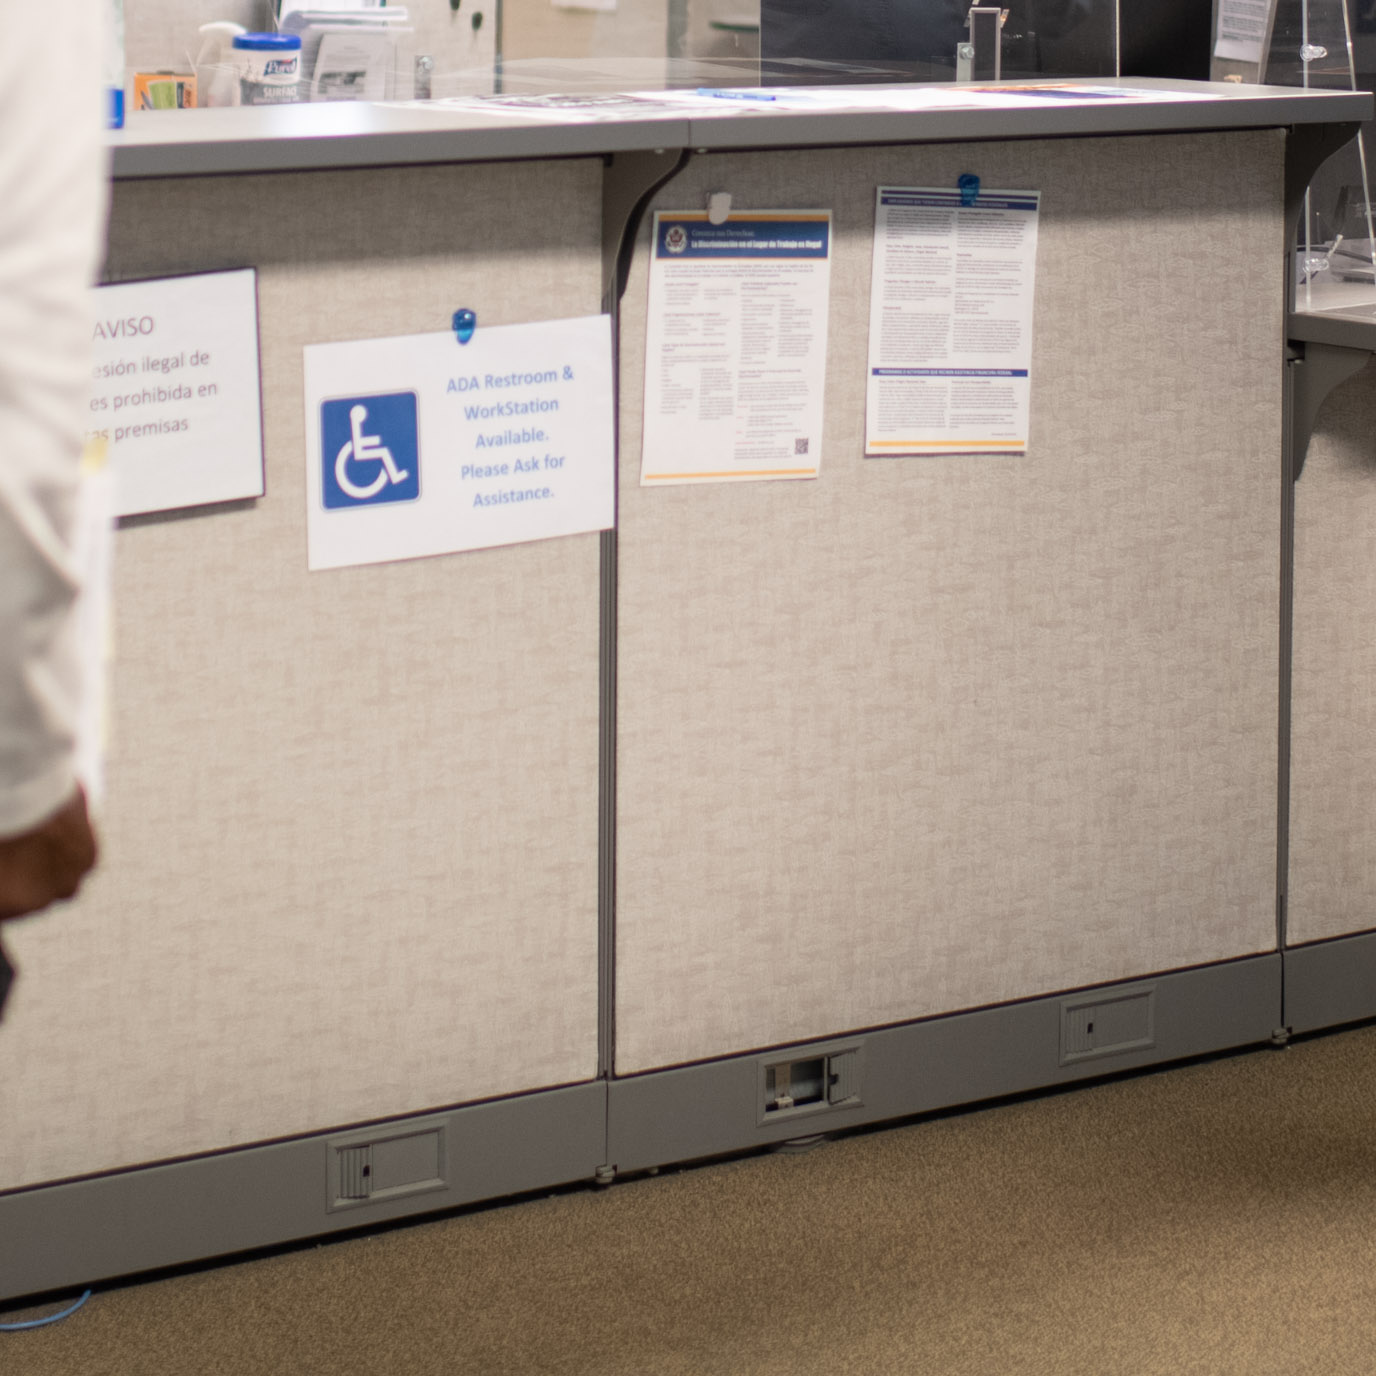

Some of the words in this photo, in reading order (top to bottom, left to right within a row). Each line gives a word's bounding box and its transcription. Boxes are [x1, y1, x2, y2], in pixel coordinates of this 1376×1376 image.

[92, 316, 154, 341] AVISO
[142, 351, 185, 375] ilegal
[189, 349, 210, 367] de
[446, 375, 480, 393] ADA
[484, 370, 558, 389] Restroom
[562, 365, 575, 381] &
[113, 383, 192, 412] prohibida
[197, 383, 218, 398] en
[464, 398, 560, 421] WorkStation
[114, 417, 189, 444] premisas
[475, 427, 549, 449] Available.
[461, 463, 509, 480] Please
[514, 456, 540, 473] Ask
[544, 454, 565, 470] for
[473, 486, 555, 508] Assistance.
